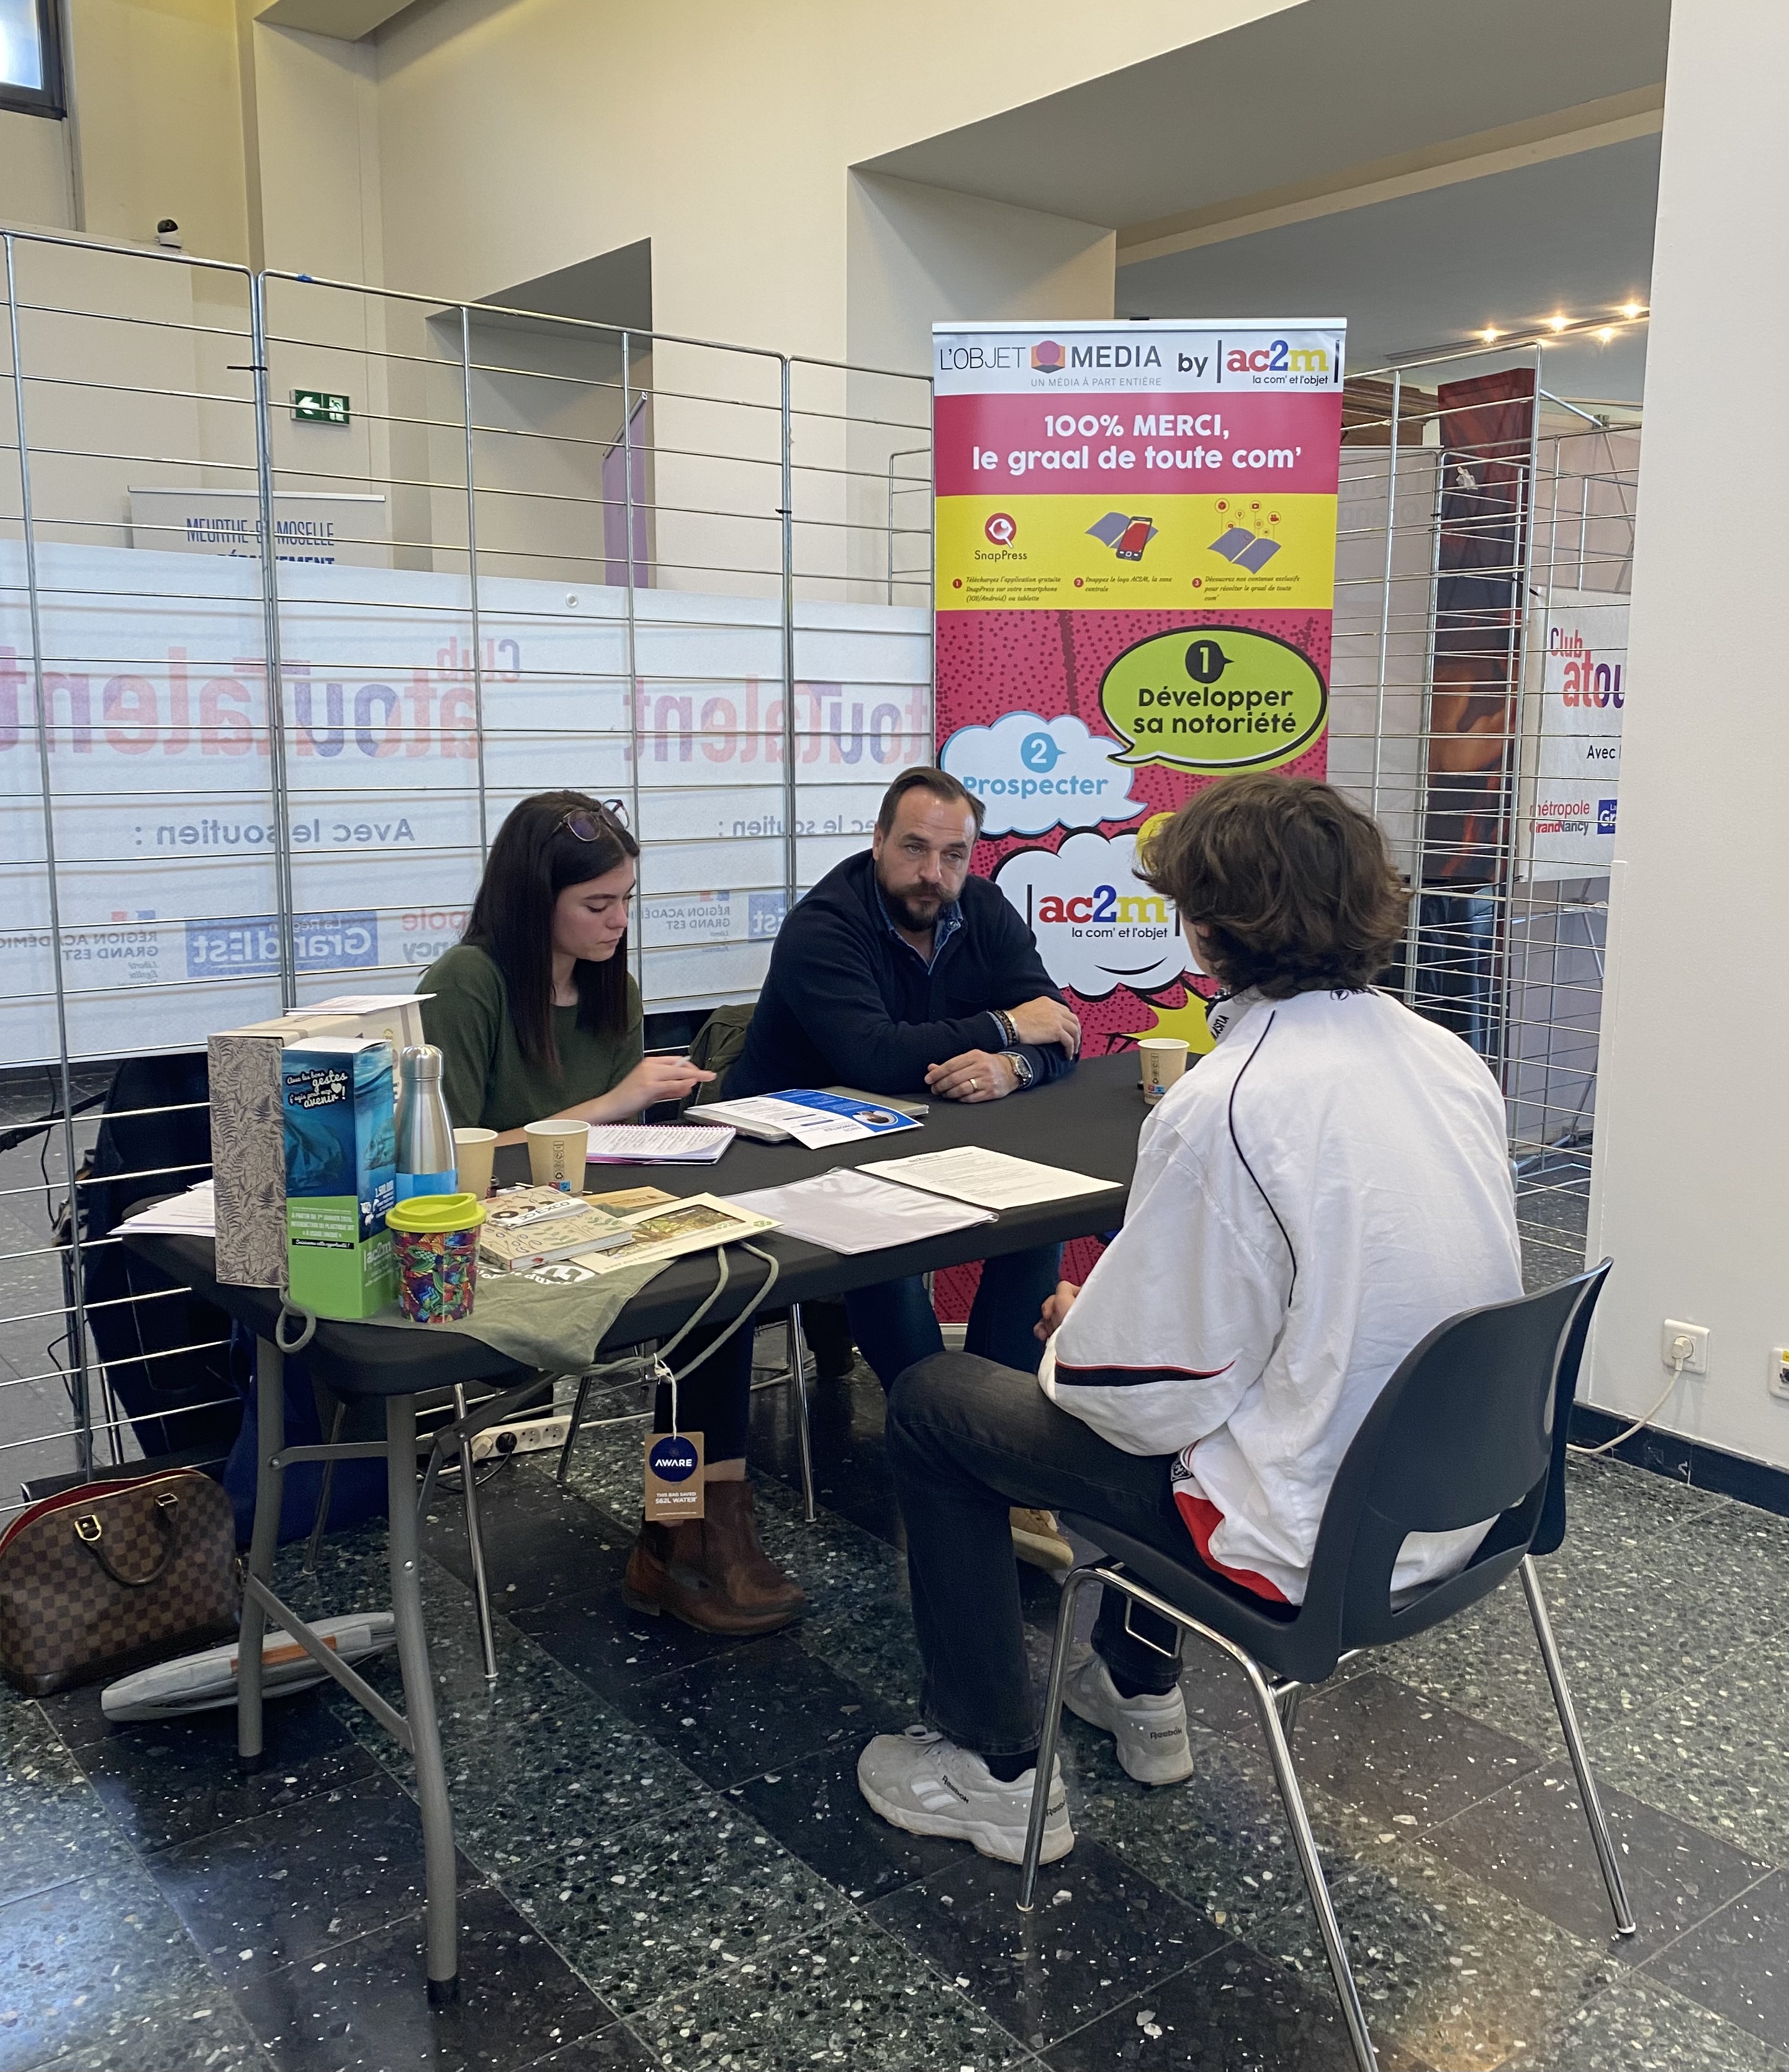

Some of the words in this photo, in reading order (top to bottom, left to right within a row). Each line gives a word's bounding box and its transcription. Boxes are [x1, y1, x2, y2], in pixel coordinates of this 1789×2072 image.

[940, 347, 1026, 370] L'OBJET
[1071, 345, 1162, 368] MEDIA
[1178, 353, 1209, 377] by
[1227, 340, 1329, 372] ac2m
[1031, 379, 1045, 387] UN
[1048, 376, 1079, 386] MÉDIA
[1082, 376, 1089, 386] À
[1092, 378, 1116, 386] PART
[1119, 376, 1161, 386] ENTIÈRE
[1253, 376, 1261, 384] la
[1264, 375, 1287, 384] com'
[1300, 375, 1328, 386] l'objet
[1044, 415, 1124, 437] 100%
[1133, 414, 1229, 440] MERCI,
[973, 446, 998, 470] le
[1007, 445, 1089, 476] graal
[1097, 446, 1136, 469] de
[1145, 445, 1222, 469] toute
[186, 518, 335, 546] MEURTHE-E-MOSELLE
[974, 550, 1027, 563] SnapPress
[1551, 627, 1582, 658] Club
[1200, 647, 1209, 674] 1
[1138, 685, 1294, 711] Développer
[1133, 717, 1163, 733] sa
[1173, 712, 1296, 733] notoriété
[1031, 738, 1047, 764] 2
[1587, 745, 1616, 759] Avec
[963, 775, 1109, 799] Prospecter
[1039, 885, 1168, 923] ac2m
[1071, 927, 1083, 938] la
[1086, 927, 1115, 938] com'
[1118, 928, 1130, 938] et
[1132, 927, 1168, 940] l'objet
[312, 1070, 348, 1094] gestes
[304, 1094, 339, 1108] avenir
[655, 1459, 692, 1467] AWARE
[1150, 1727, 1183, 1739] Reebok
[942, 1775, 970, 1804] Reebok
